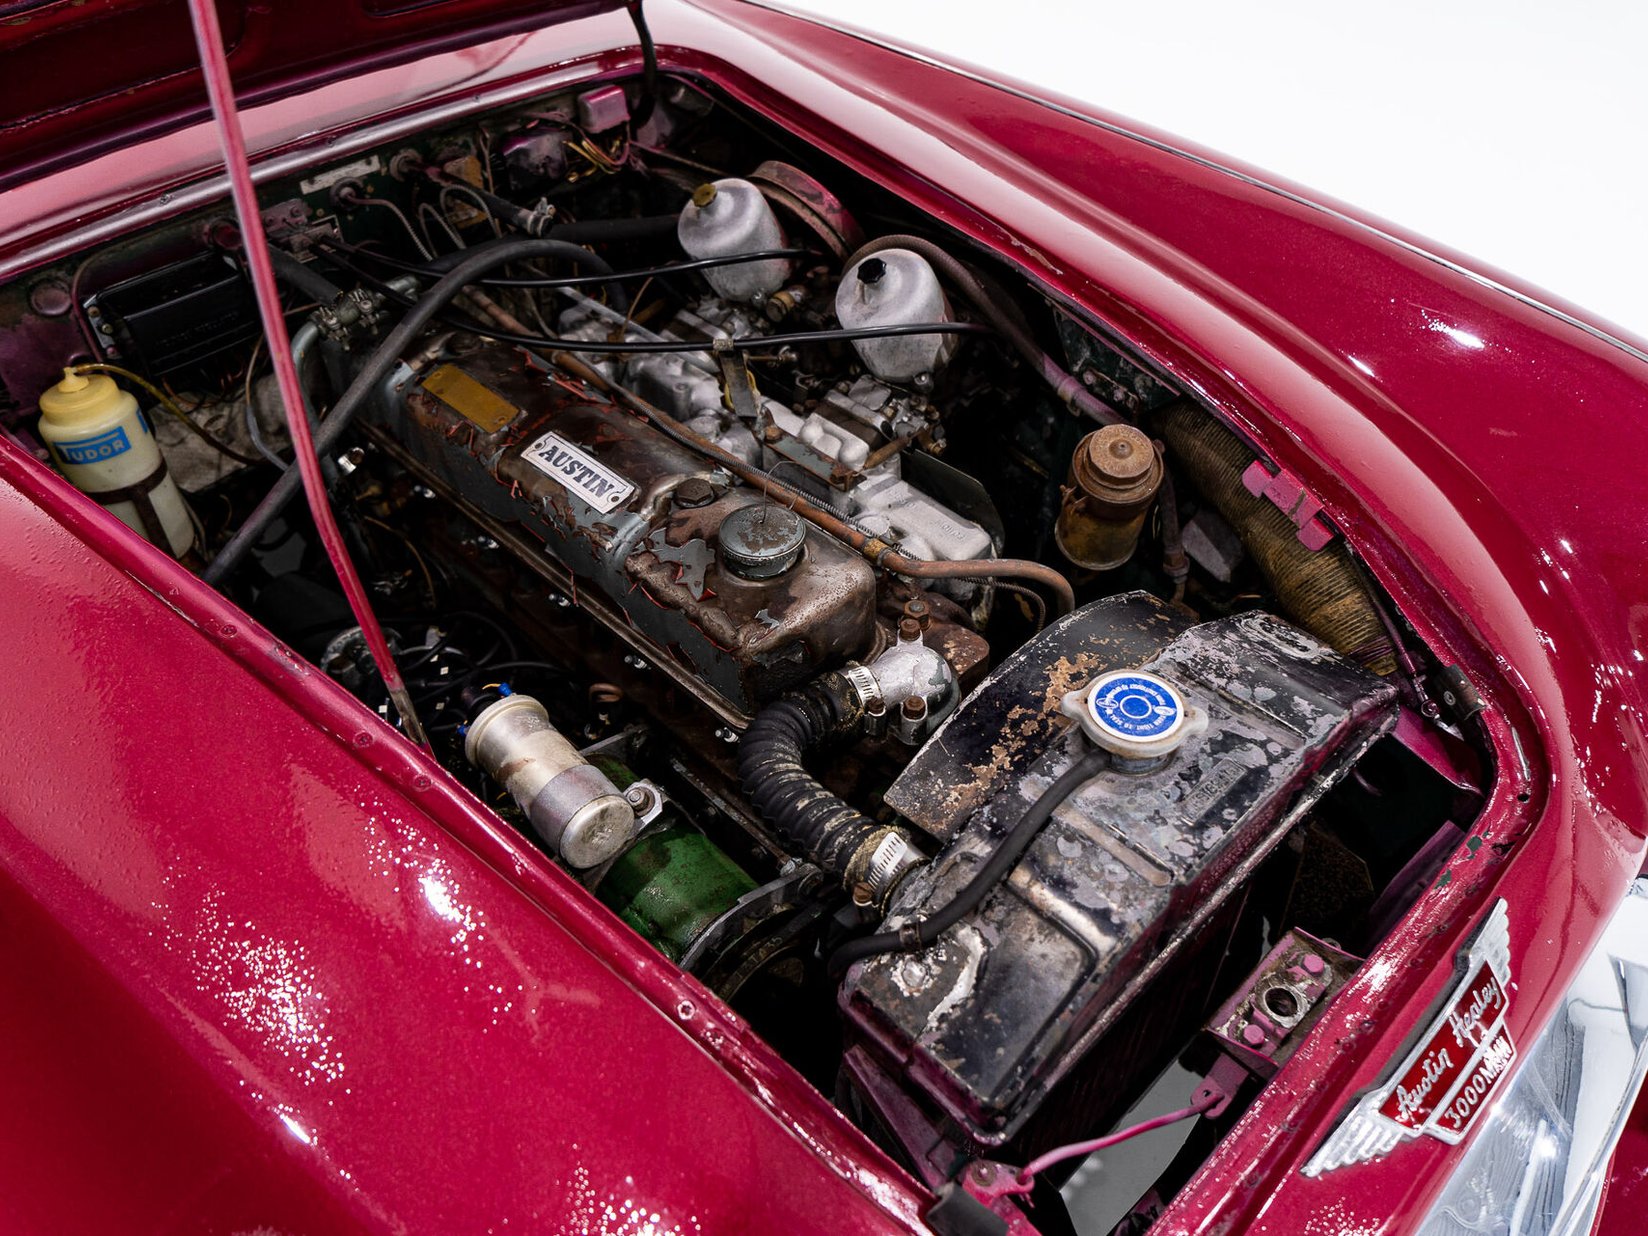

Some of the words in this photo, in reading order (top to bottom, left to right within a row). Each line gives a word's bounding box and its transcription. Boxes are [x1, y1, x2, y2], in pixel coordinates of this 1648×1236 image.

[58, 432, 125, 461] TUDOR
[538, 445, 615, 498] AUSTIN
[1395, 1047, 1454, 1122] Austin
[1449, 977, 1501, 1048] Healey
